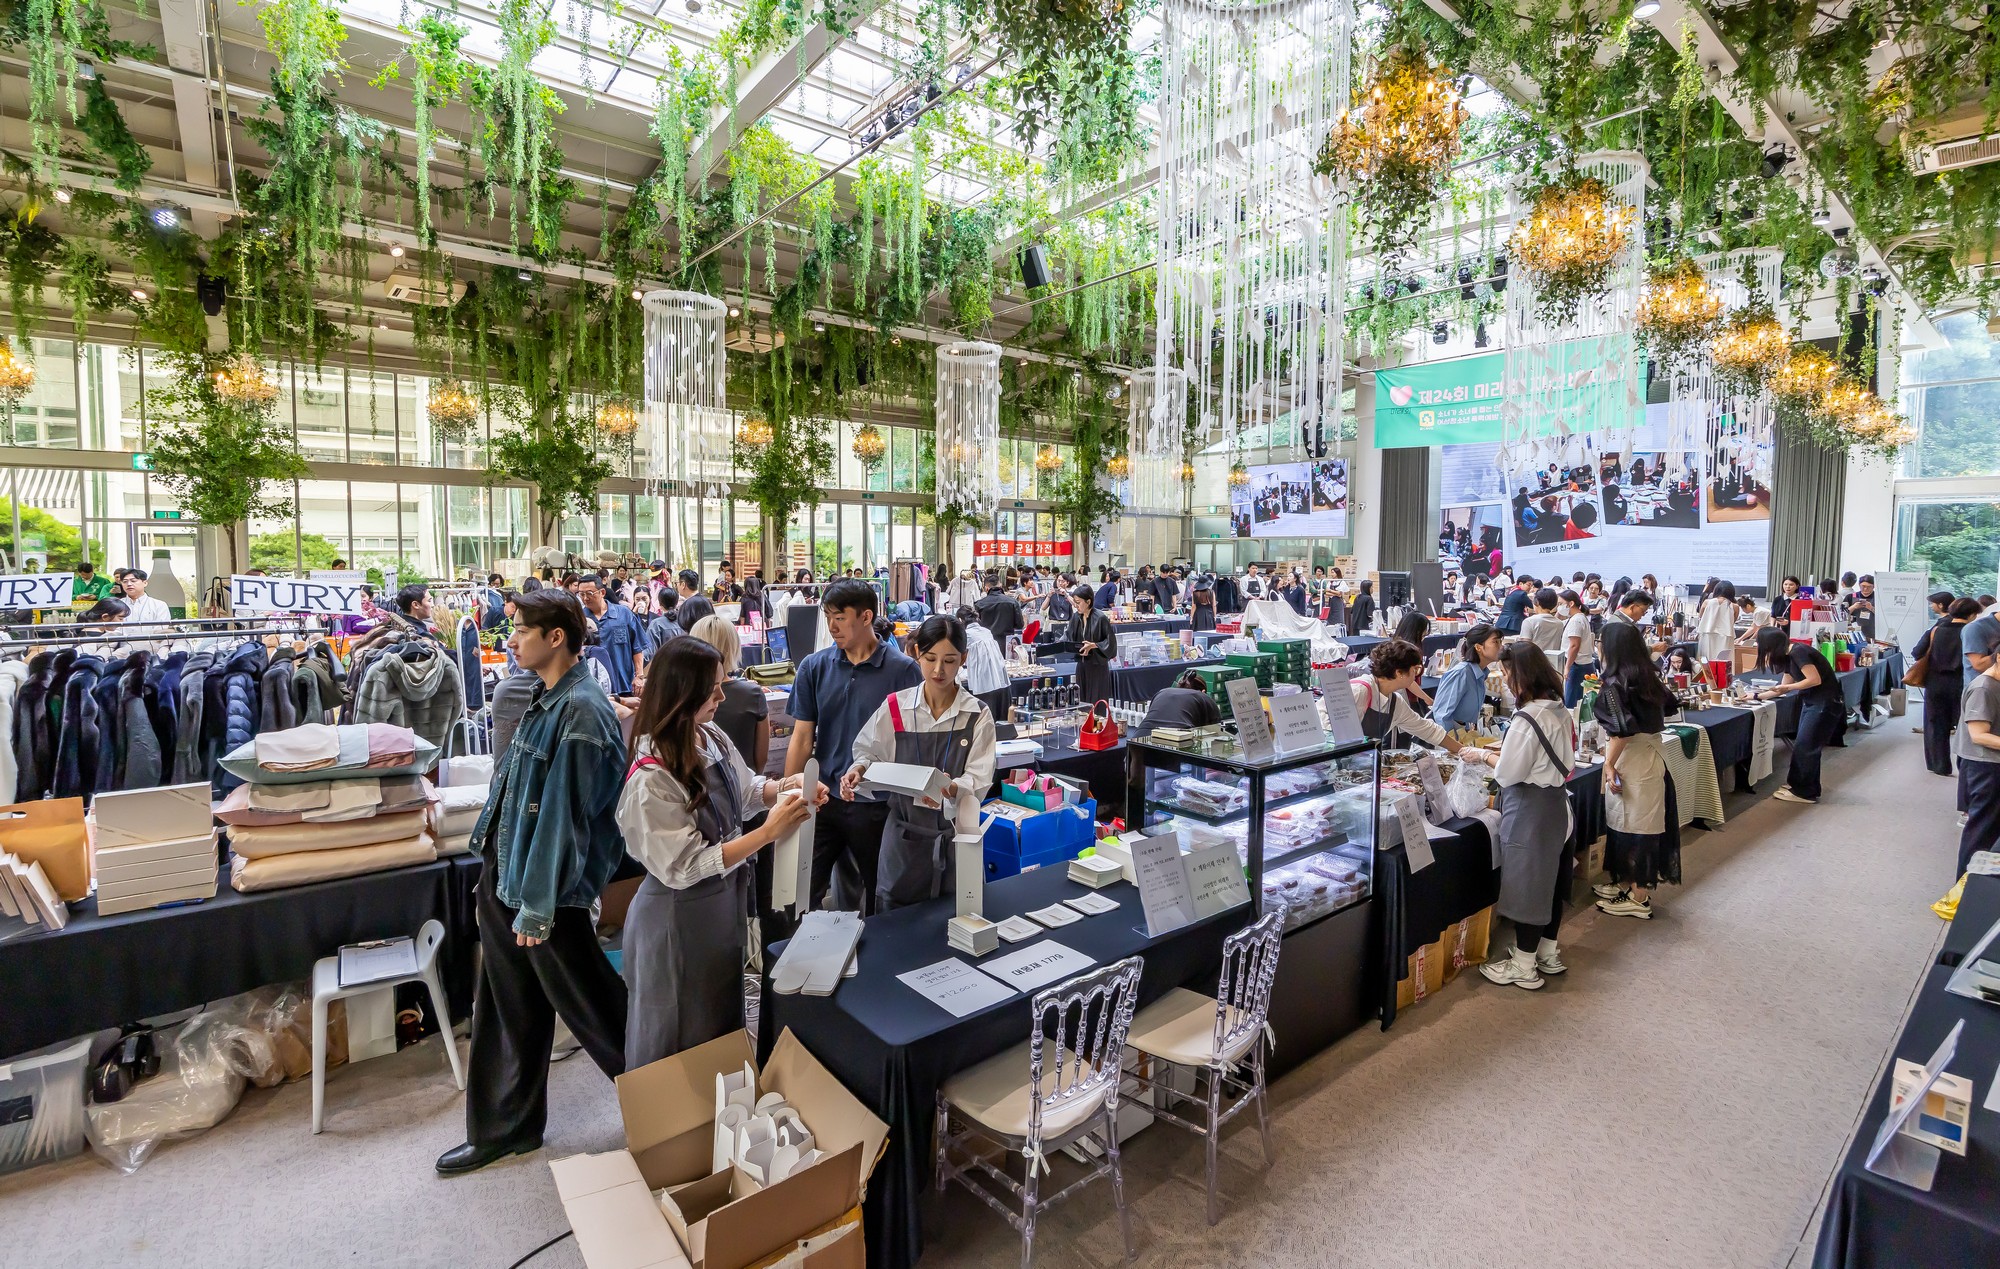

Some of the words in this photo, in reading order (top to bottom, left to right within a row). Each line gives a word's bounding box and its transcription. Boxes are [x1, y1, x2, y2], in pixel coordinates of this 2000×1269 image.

[1418, 385, 1469, 405] 제24회
[0, 577, 72, 606] RY
[234, 578, 360, 612] FURY
[1041, 953, 1064, 965] 1779
